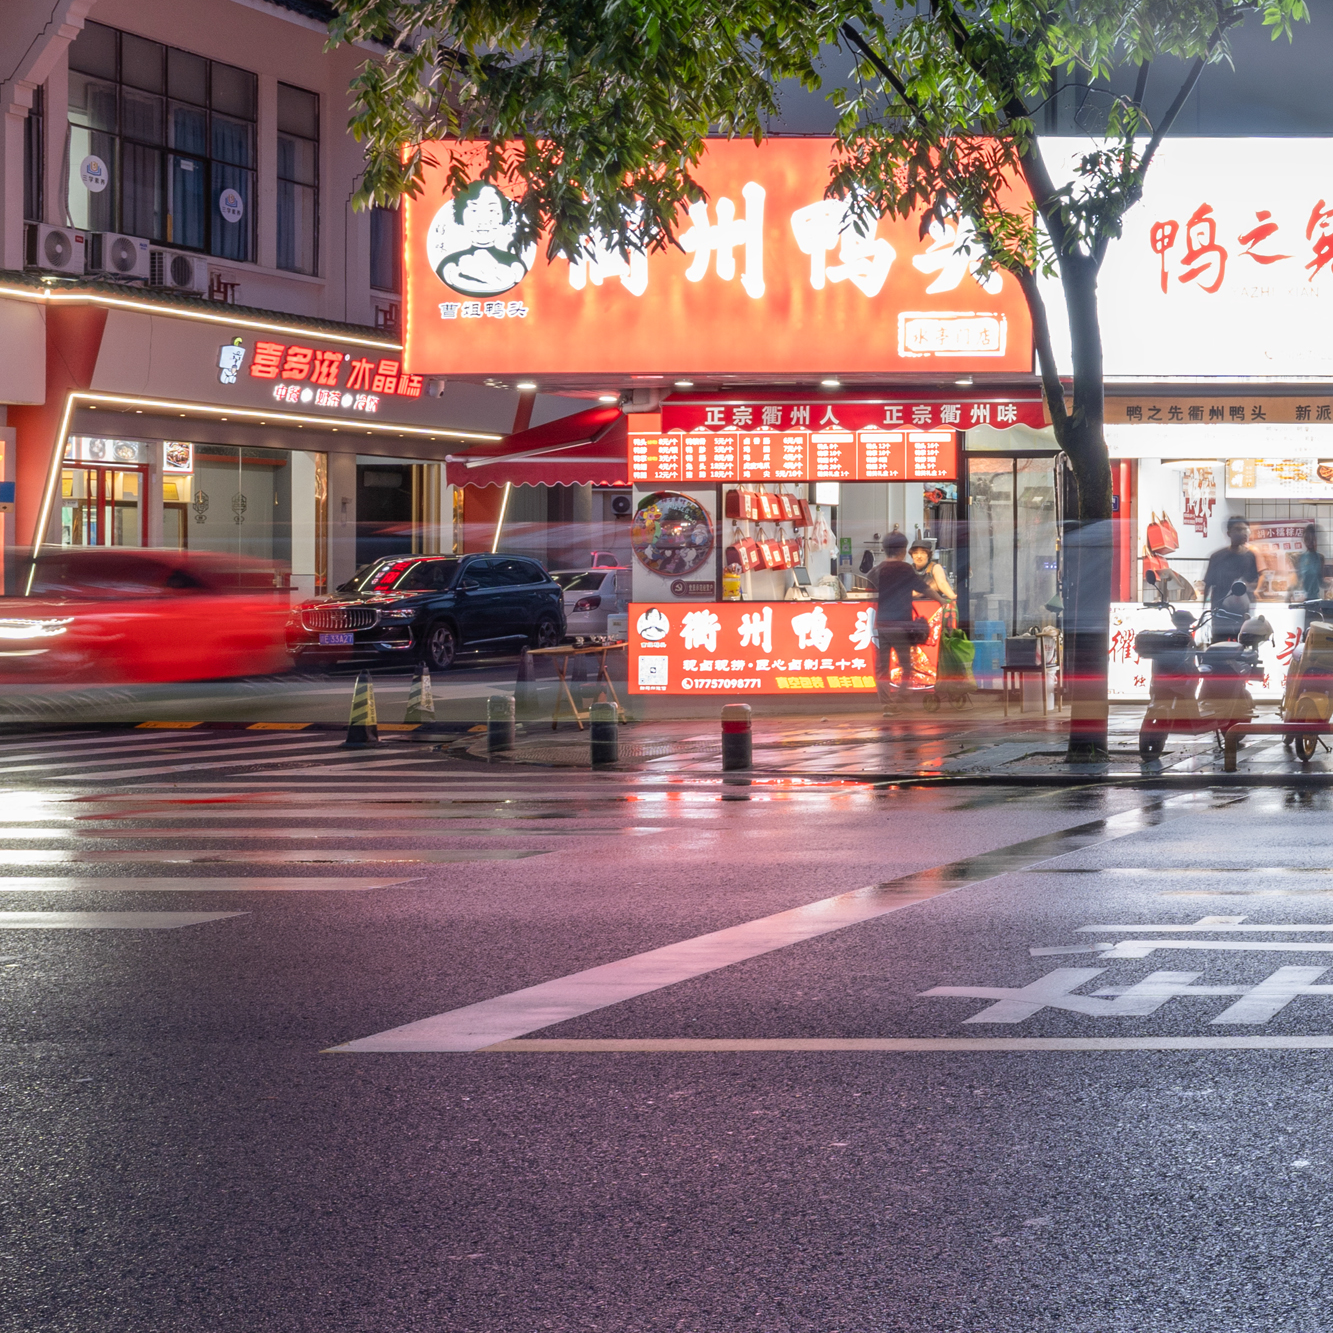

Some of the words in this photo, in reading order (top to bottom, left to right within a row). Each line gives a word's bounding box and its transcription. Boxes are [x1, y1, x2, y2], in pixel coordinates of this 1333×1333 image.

[251, 341, 343, 386] 喜多滋
[704, 405, 840, 425] 正宗衢州人
[883, 405, 1018, 425] 正宗衢州味
[1126, 405, 1267, 422] 鸭之先衢州鸭头
[679, 606, 880, 654] 衢州鸭头
